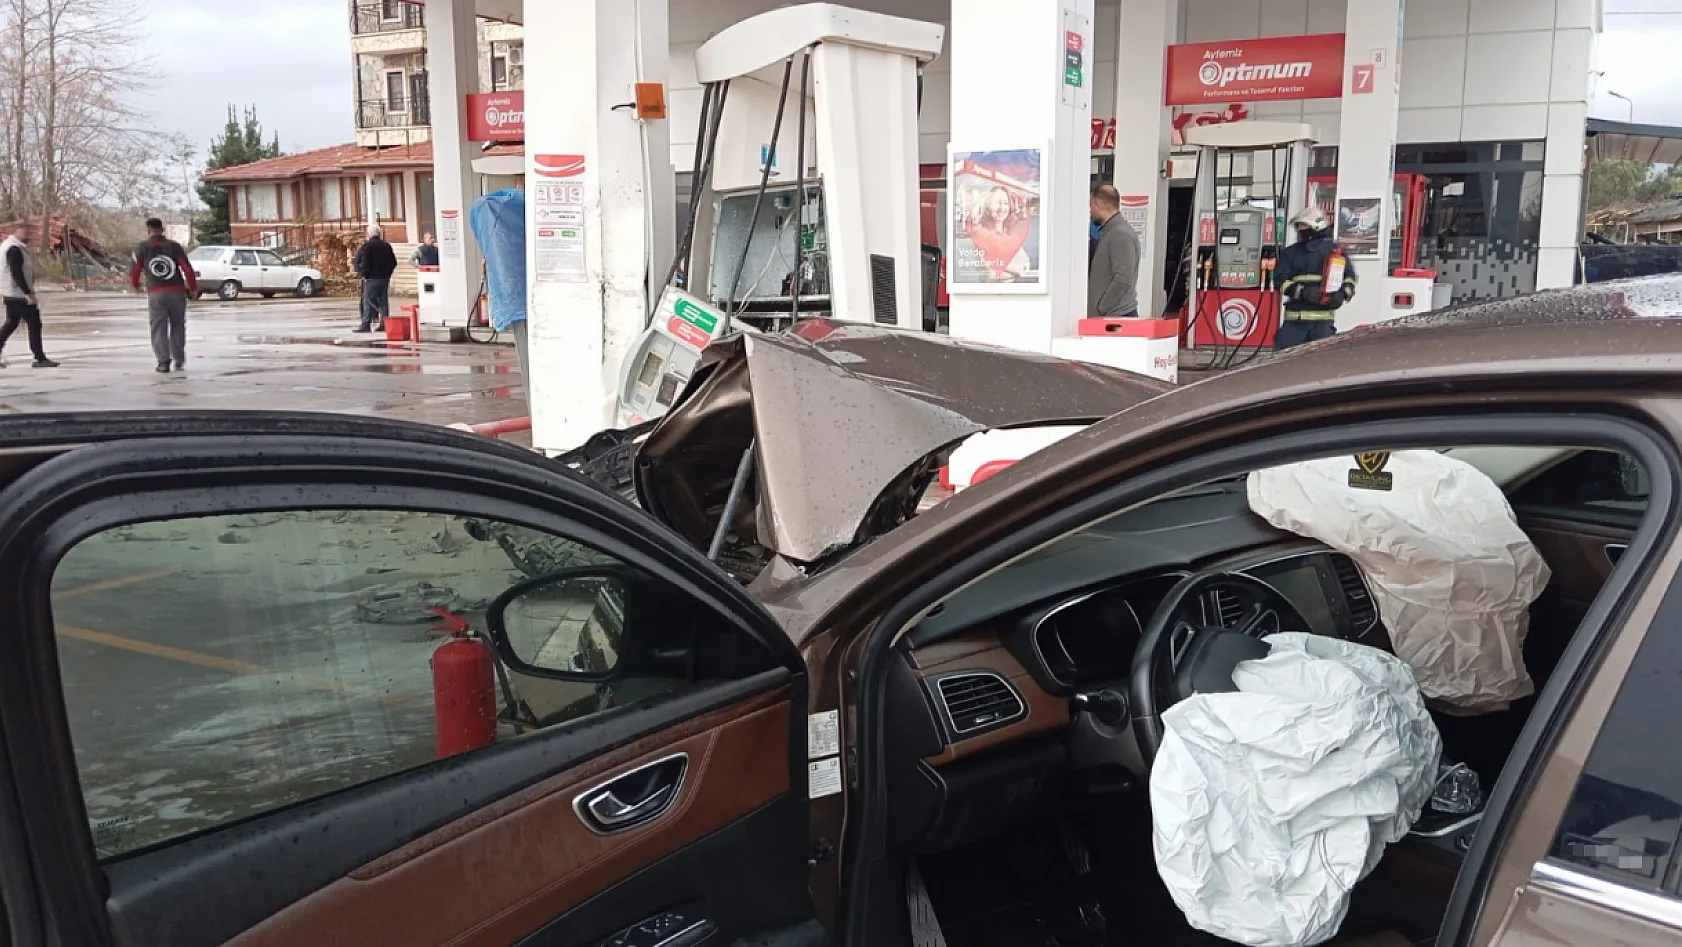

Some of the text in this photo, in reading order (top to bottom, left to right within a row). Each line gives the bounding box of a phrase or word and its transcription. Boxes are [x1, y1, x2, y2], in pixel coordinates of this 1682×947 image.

[1203, 48, 1244, 60] Aytemiz
[1199, 61, 1312, 87] Optimum
[1358, 70, 1371, 88] 7
